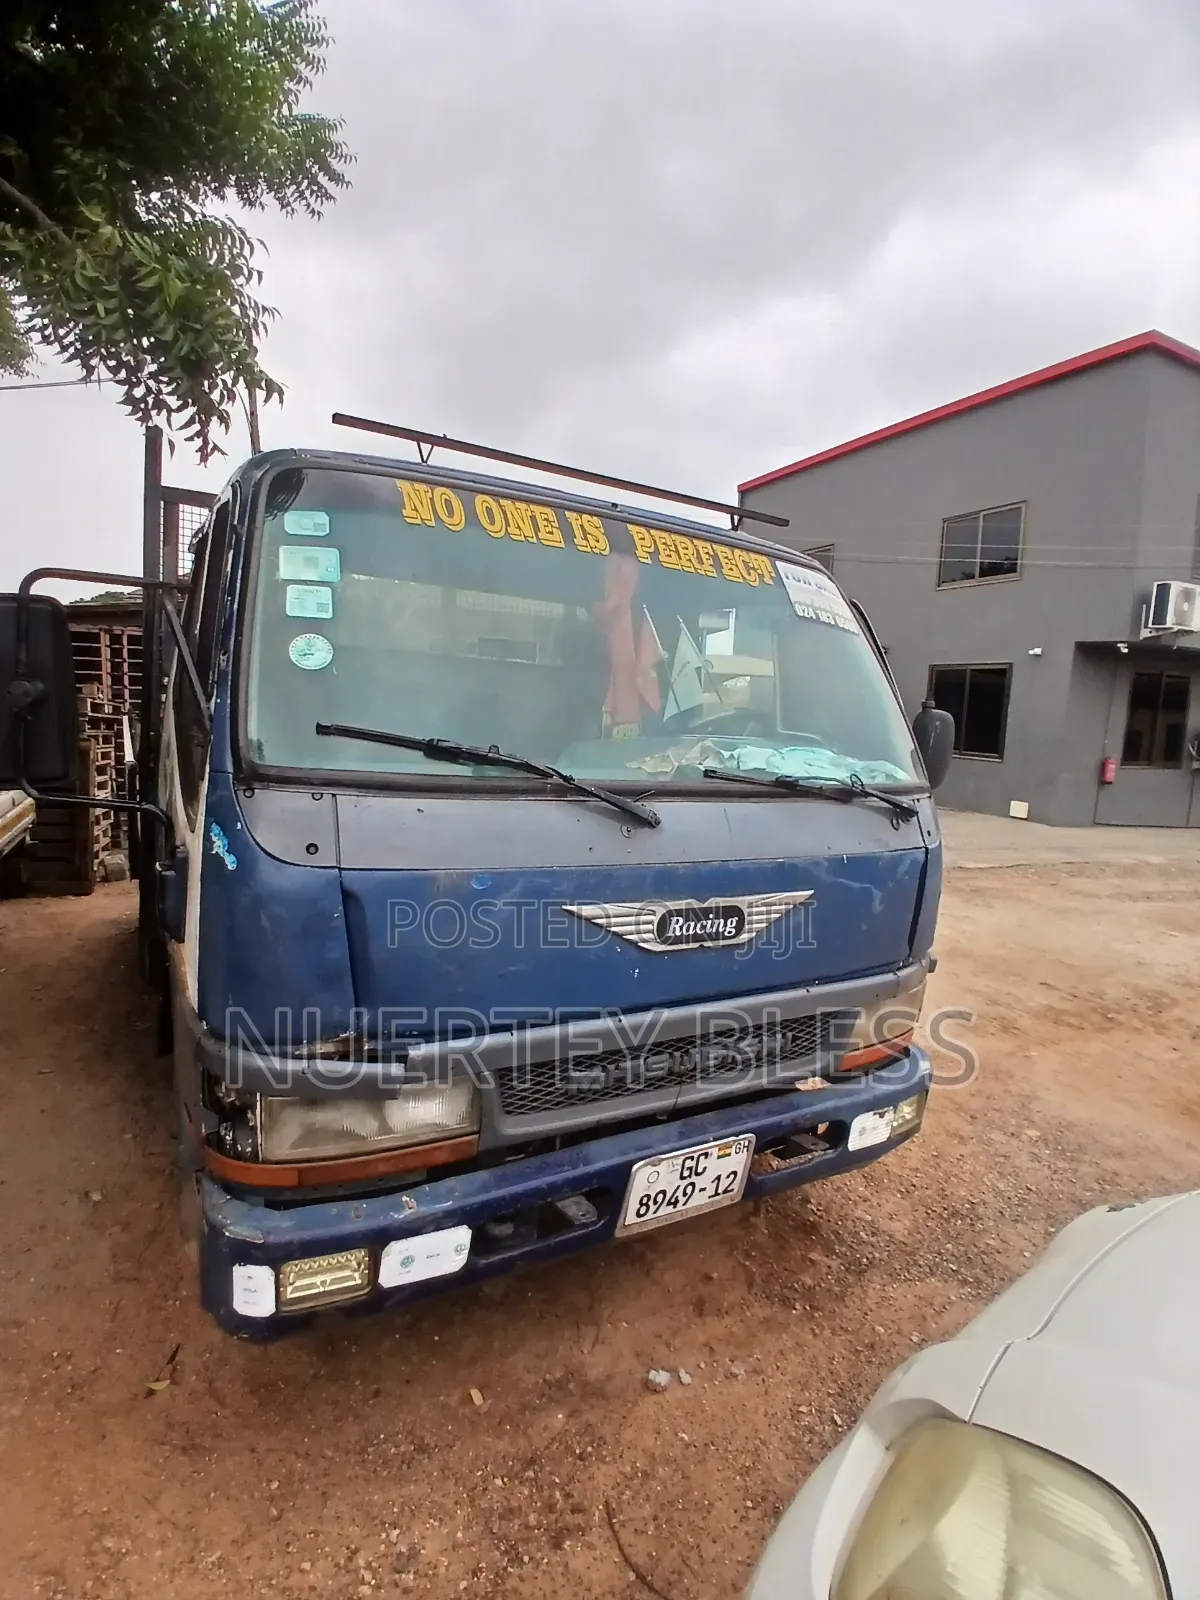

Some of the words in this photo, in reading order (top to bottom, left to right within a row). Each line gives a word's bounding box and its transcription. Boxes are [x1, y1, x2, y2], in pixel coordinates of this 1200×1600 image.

[395, 479, 466, 532] NO
[474, 494, 565, 548] ONE
[565, 510, 610, 556] IS
[626, 523, 777, 587] PERFECT
[666, 913, 739, 937] Racing
[734, 1140, 750, 1155] GH
[679, 1151, 710, 1181] GC
[635, 1170, 738, 1218] 8949-12
